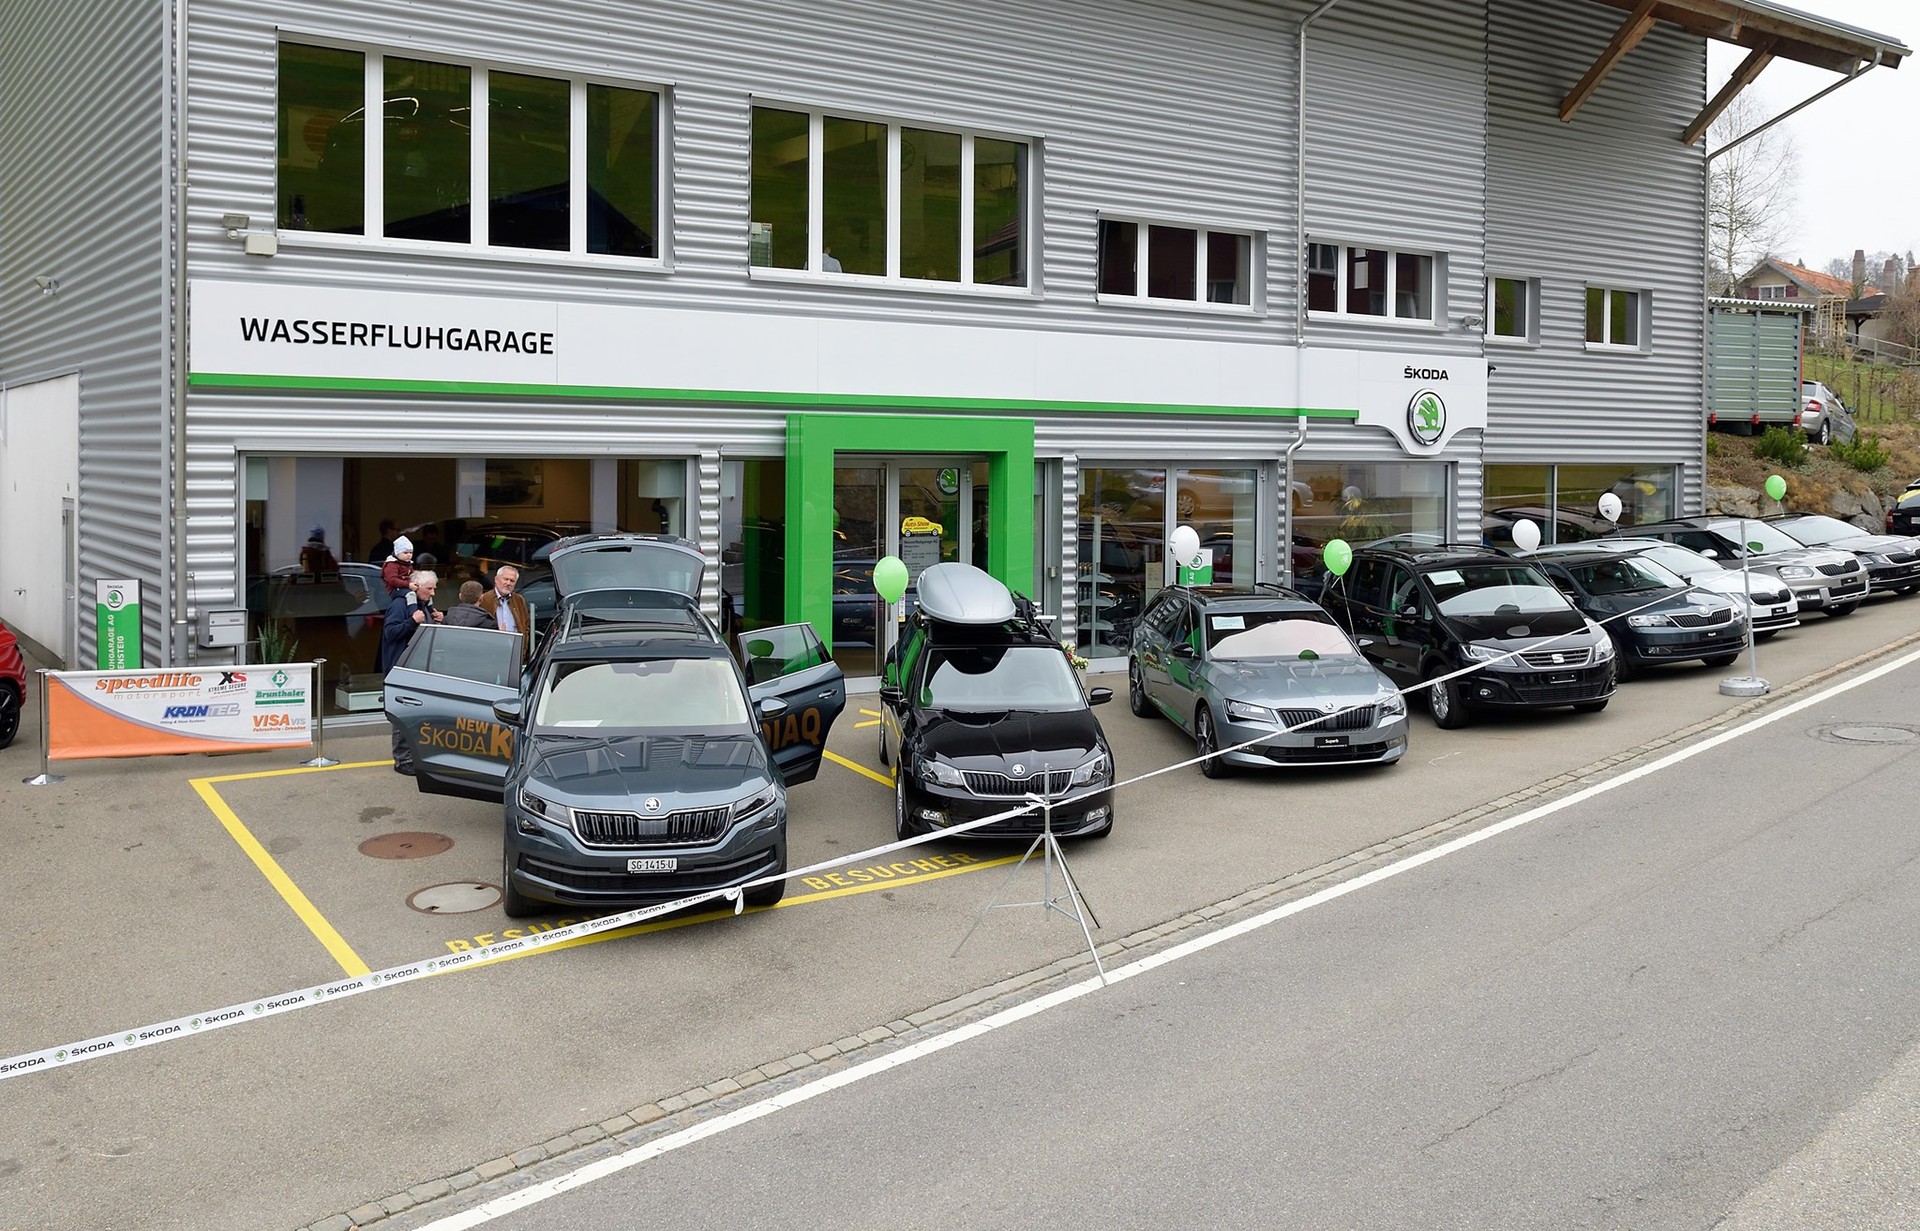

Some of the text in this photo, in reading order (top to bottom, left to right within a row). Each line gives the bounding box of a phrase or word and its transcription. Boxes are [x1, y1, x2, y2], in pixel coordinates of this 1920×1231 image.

[240, 317, 554, 354] WASSERFLUHGARAGE
[1404, 365, 1449, 380] ŠKODA
[95, 672, 202, 694] speedlife
[113, 690, 201, 700] motorsport
[256, 690, 305, 698] Brunthaler
[456, 717, 489, 734] NEW
[419, 722, 487, 755] ŠKODA
[631, 860, 642, 870] SG
[645, 860, 666, 869] 1415
[801, 853, 979, 890] BESUCHER
[0, 1056, 46, 1073] ŠKODA
[71, 1041, 115, 1056] ŠKODA
[139, 1025, 181, 1041] ŠKODA
[204, 1010, 245, 1024] ŠKODA
[267, 995, 306, 1010] ŠKODA
[326, 981, 364, 996] ŠKODA
[384, 967, 420, 981] ŠKODA
[438, 954, 473, 968] ŠKODA
[491, 941, 525, 955] ŠKODA
[542, 928, 574, 942] ŠKODA
